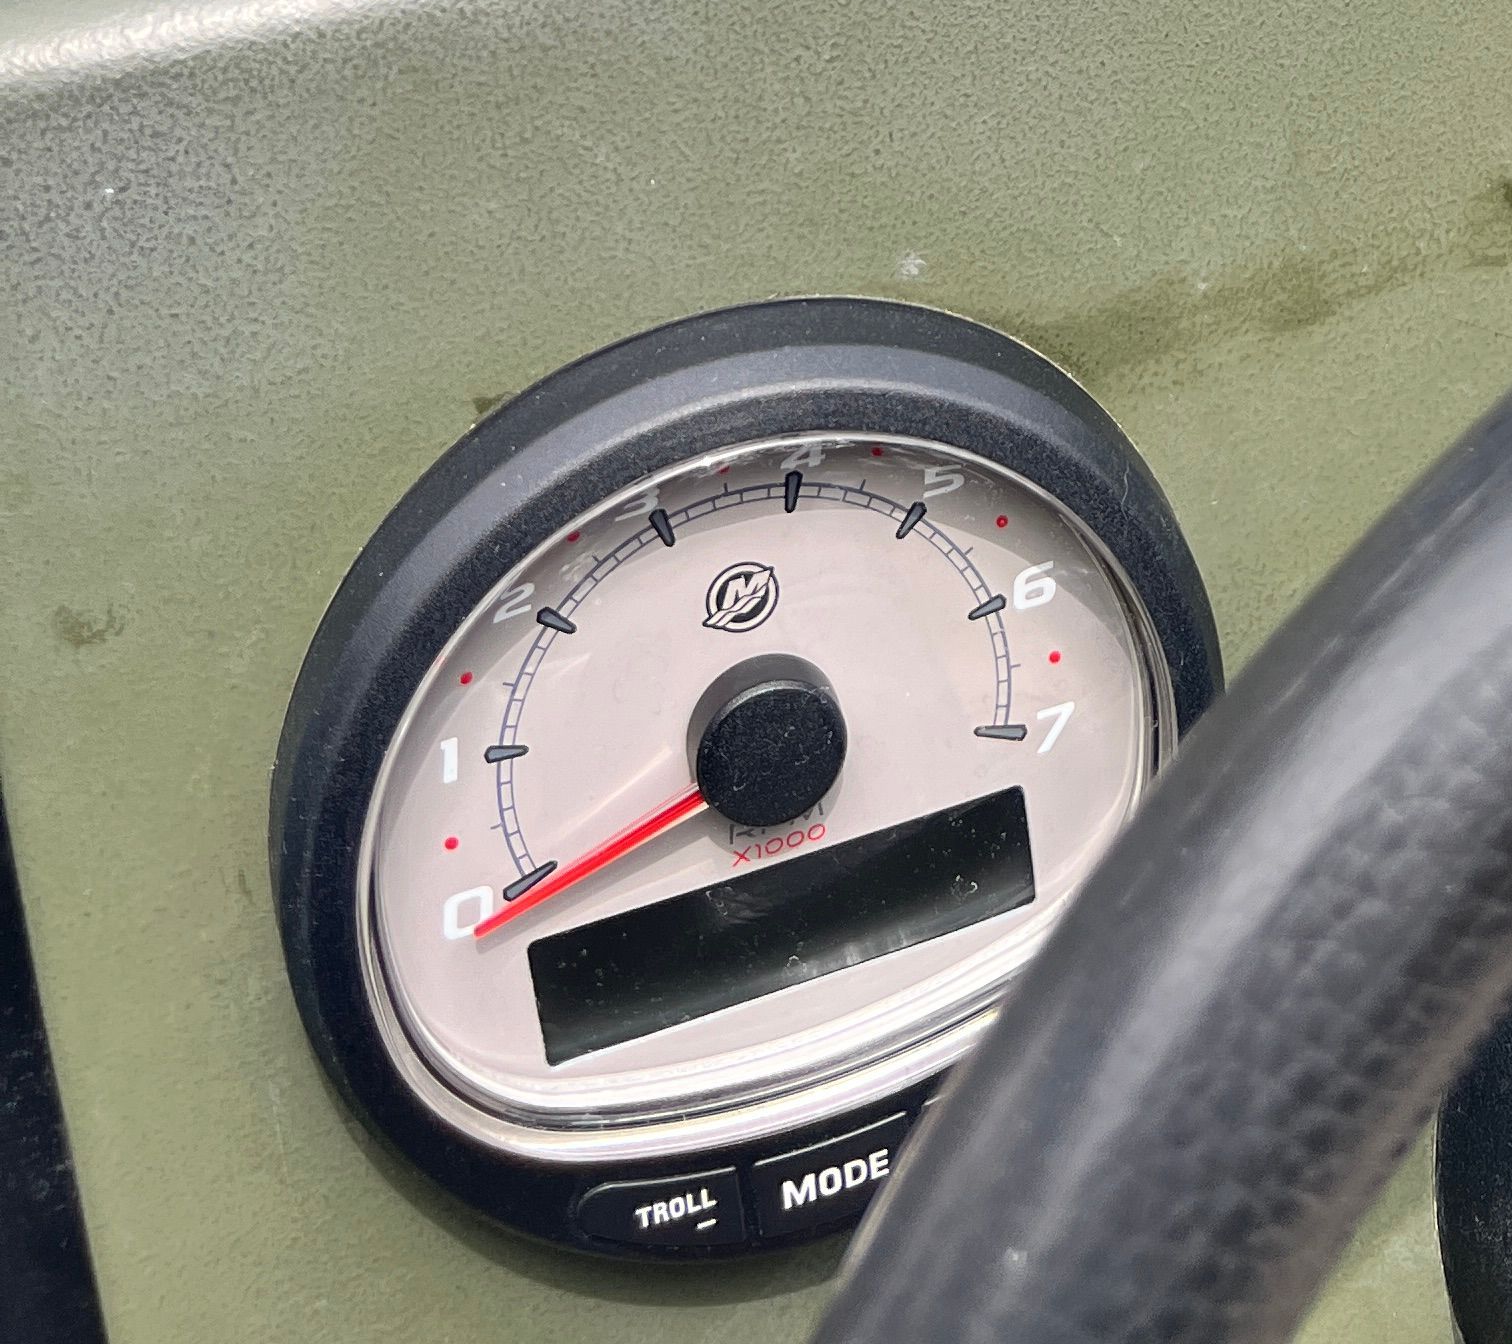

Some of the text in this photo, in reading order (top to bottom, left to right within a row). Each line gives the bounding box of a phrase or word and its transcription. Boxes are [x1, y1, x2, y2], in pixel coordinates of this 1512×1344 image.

[614, 484, 662, 522] 3
[922, 463, 966, 500] 5
[492, 580, 537, 625] 2
[1012, 560, 1058, 614] 6
[1034, 701, 1077, 756] 7
[439, 736, 461, 784] 1
[732, 823, 826, 868] X1000
[441, 882, 494, 941] 0
[780, 1148, 890, 1211] MODE
[635, 1187, 718, 1230] TROLL
